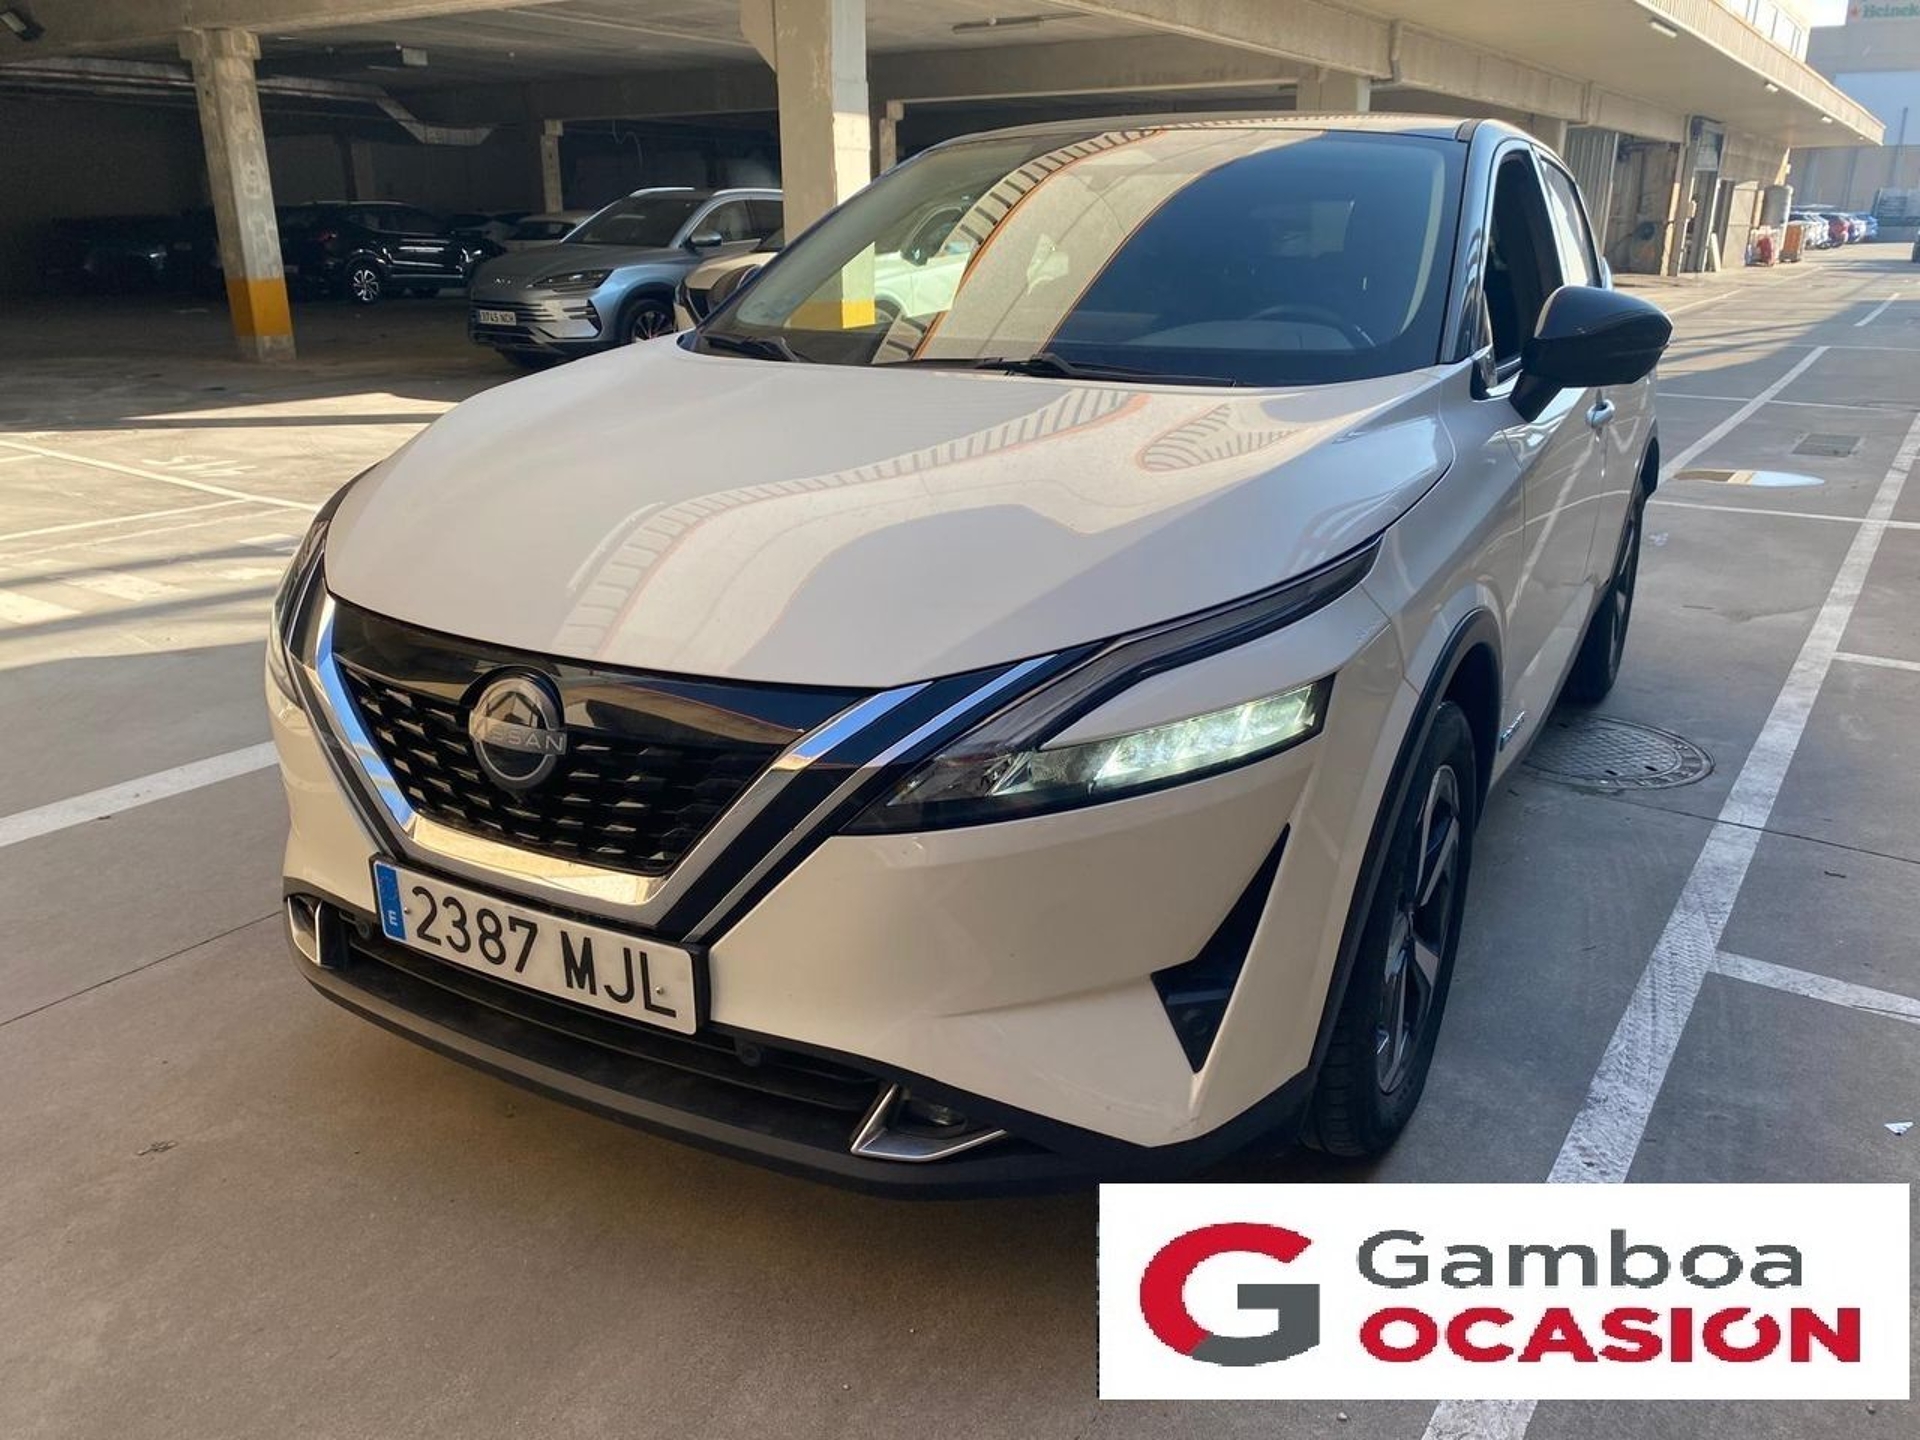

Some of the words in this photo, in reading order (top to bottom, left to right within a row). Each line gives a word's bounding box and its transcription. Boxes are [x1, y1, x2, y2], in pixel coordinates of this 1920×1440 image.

[388, 910, 398, 926] E
[412, 886, 538, 973] 2387
[561, 930, 677, 1018] MJL
